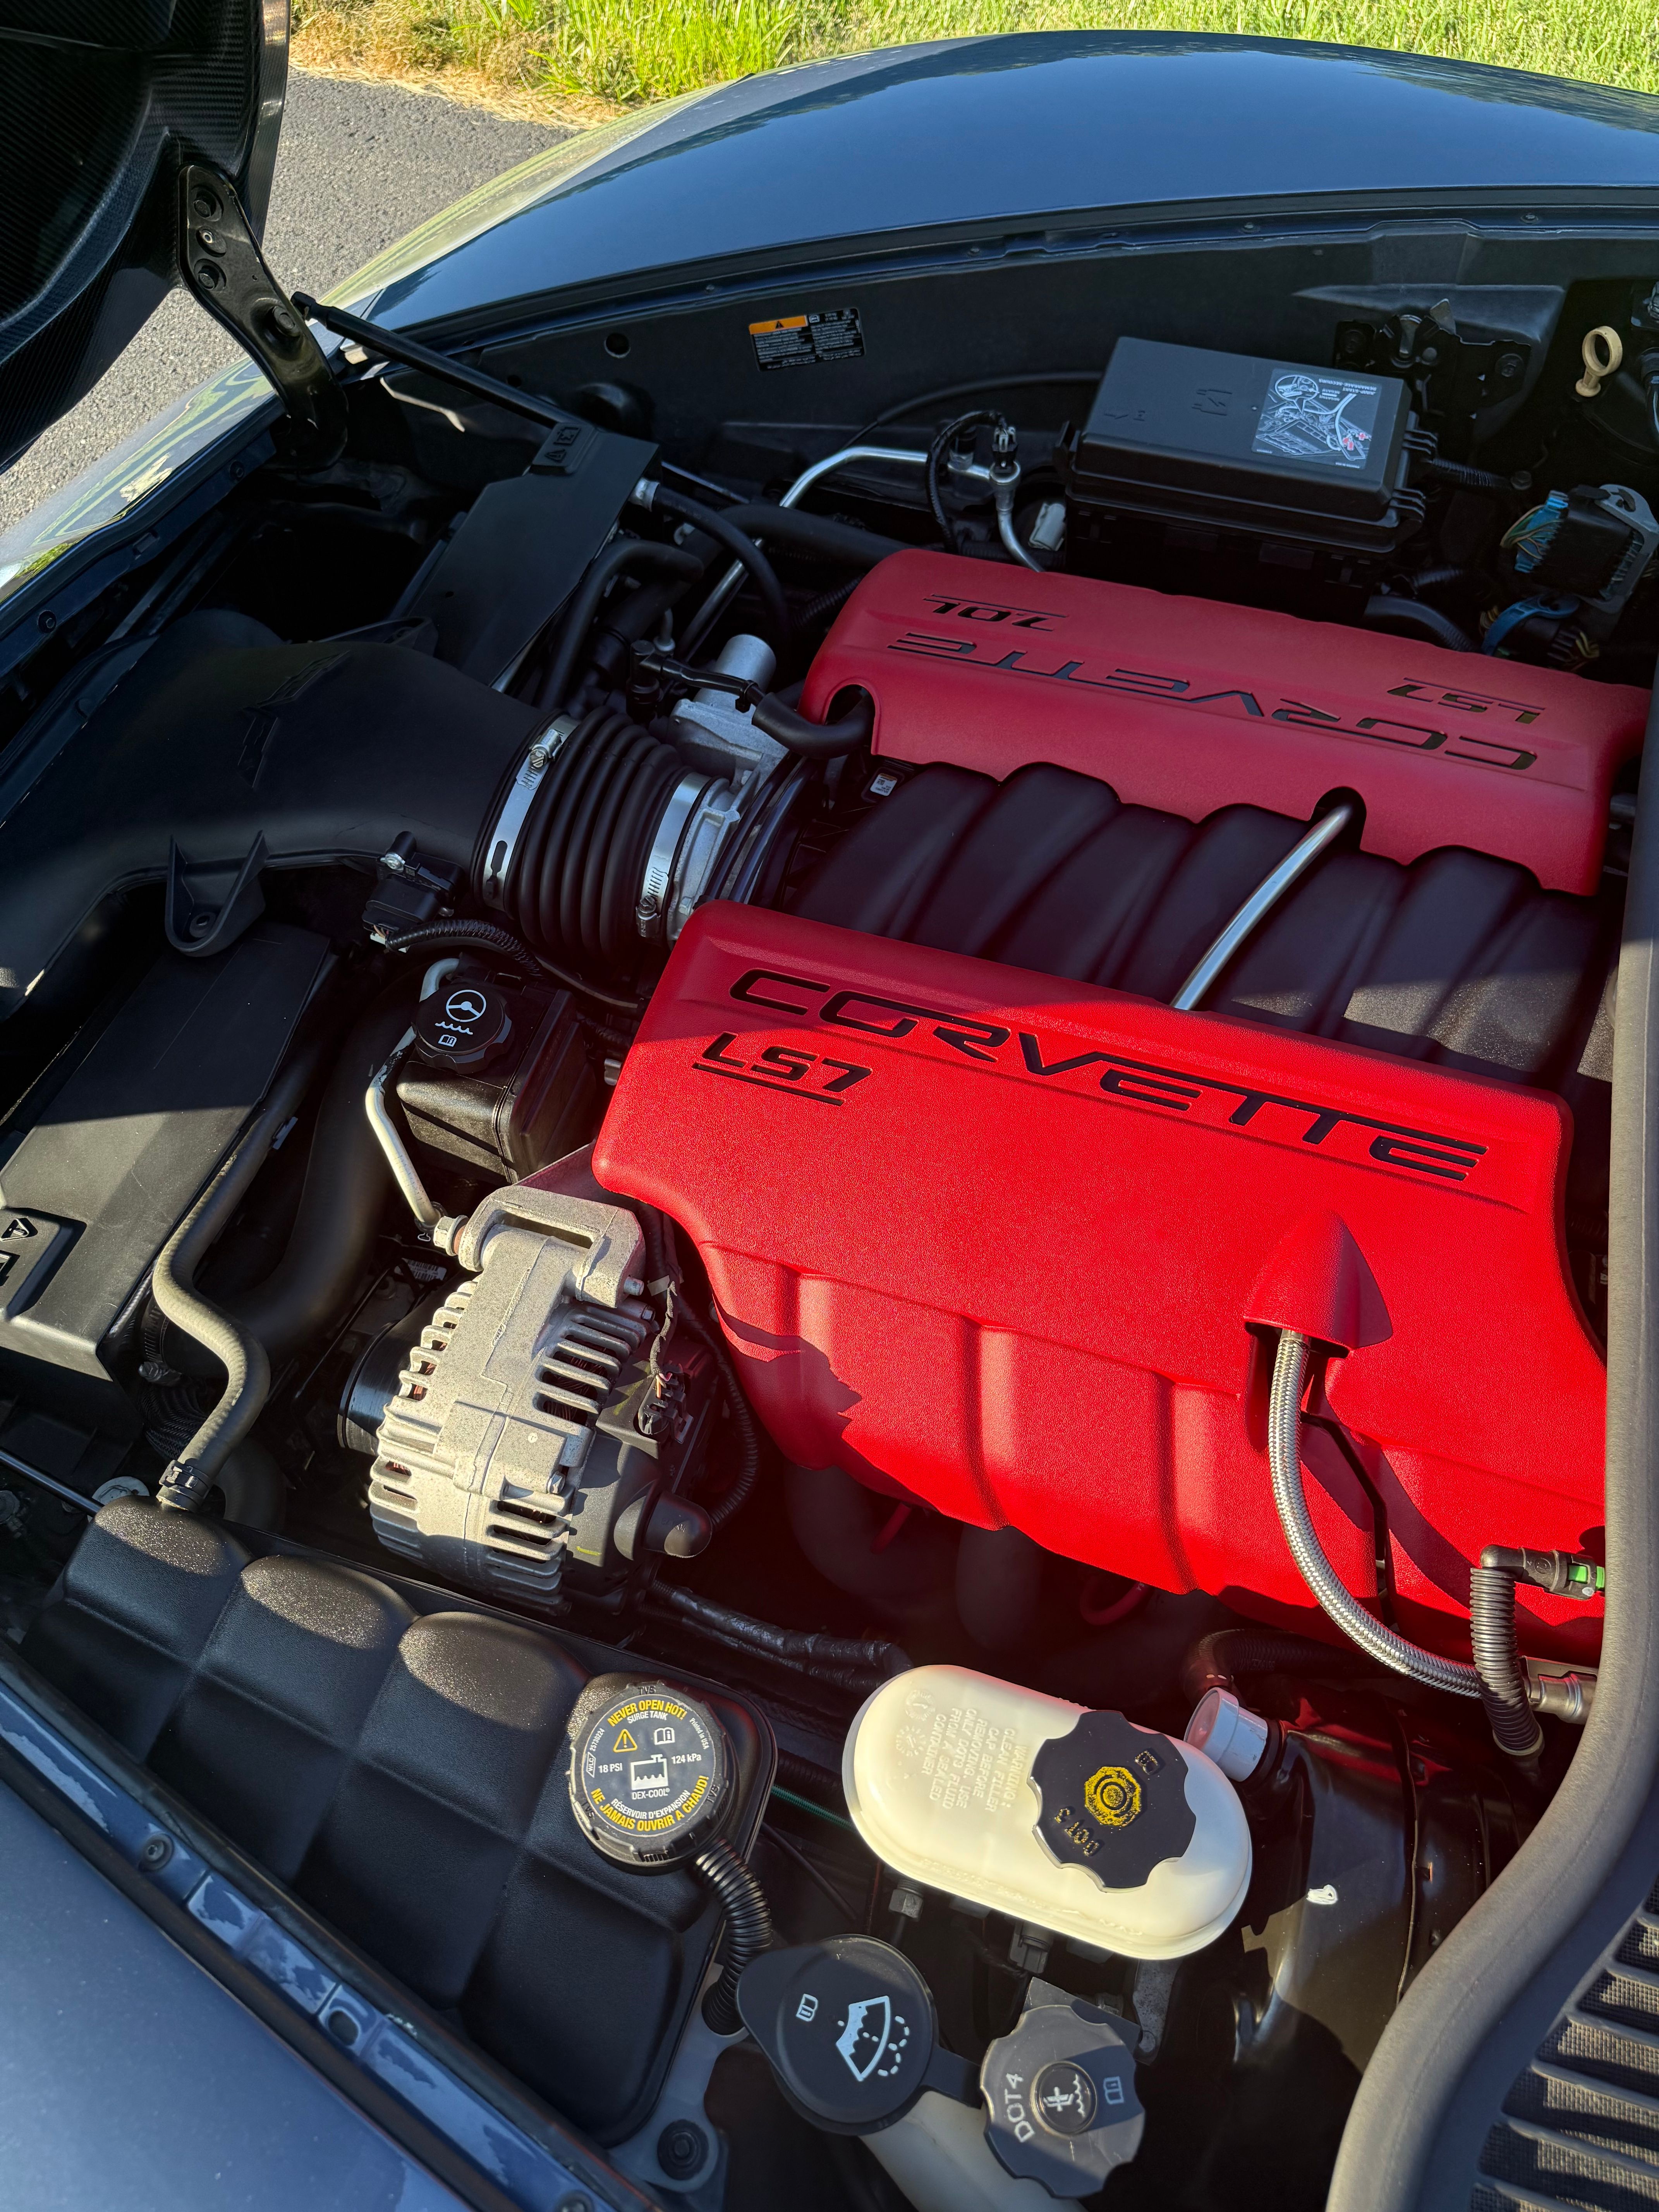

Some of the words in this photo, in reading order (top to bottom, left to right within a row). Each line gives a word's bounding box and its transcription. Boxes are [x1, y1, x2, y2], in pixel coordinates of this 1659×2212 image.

[923, 598, 1055, 632] 7.0L
[887, 633, 1537, 770] CORVETTE
[1387, 684, 1541, 724] LS7
[702, 1031, 872, 1092] LS7
[729, 968, 1489, 1181] CORVETTE
[638, 1686, 656, 1695] TVS
[607, 1703, 638, 1727] NEVER
[639, 1700, 664, 1711] OPEN
[665, 1702, 687, 1720] HOT!
[627, 1711, 649, 1724] SURGE
[650, 1711, 668, 1720] TANK
[946, 1708, 962, 1738] FROM
[962, 1709, 977, 1736] ONLY
[590, 1728, 605, 1751] 25730224
[690, 1717, 703, 1734] Printed
[701, 1738, 709, 1749] USA
[921, 1714, 946, 1775] CONTAINER
[941, 1740, 953, 1750] A
[963, 1718, 988, 1778] REMOVING.
[986, 1727, 999, 1750] CAP
[996, 1728, 1016, 1765] CLEAN
[598, 1764, 608, 1773] 18
[610, 1763, 623, 1772] PSI
[671, 1755, 686, 1764] 124
[687, 1753, 701, 1762] kPa
[929, 1755, 950, 1801] SEALED
[943, 1773, 960, 1809] FLUID
[973, 1753, 993, 1798] BEFORE
[985, 1770, 1005, 1812] FILLER
[591, 1788, 606, 1805] NE
[599, 1803, 636, 1829] JAMAIS
[637, 1814, 675, 1831] OUVRIR
[682, 1775, 709, 1813] CHAUD!
[611, 1798, 647, 1819] RÉSERVOIR
[648, 1790, 690, 1819] D'EXPANSION
[705, 1784, 720, 1803] TVS
[956, 1785, 971, 1808] USE
[1054, 1808, 1070, 1823] 3
[1065, 1822, 1099, 1856] DOT
[1006, 2073, 1024, 2089] 4
[1004, 2088, 1035, 2142] DOT
